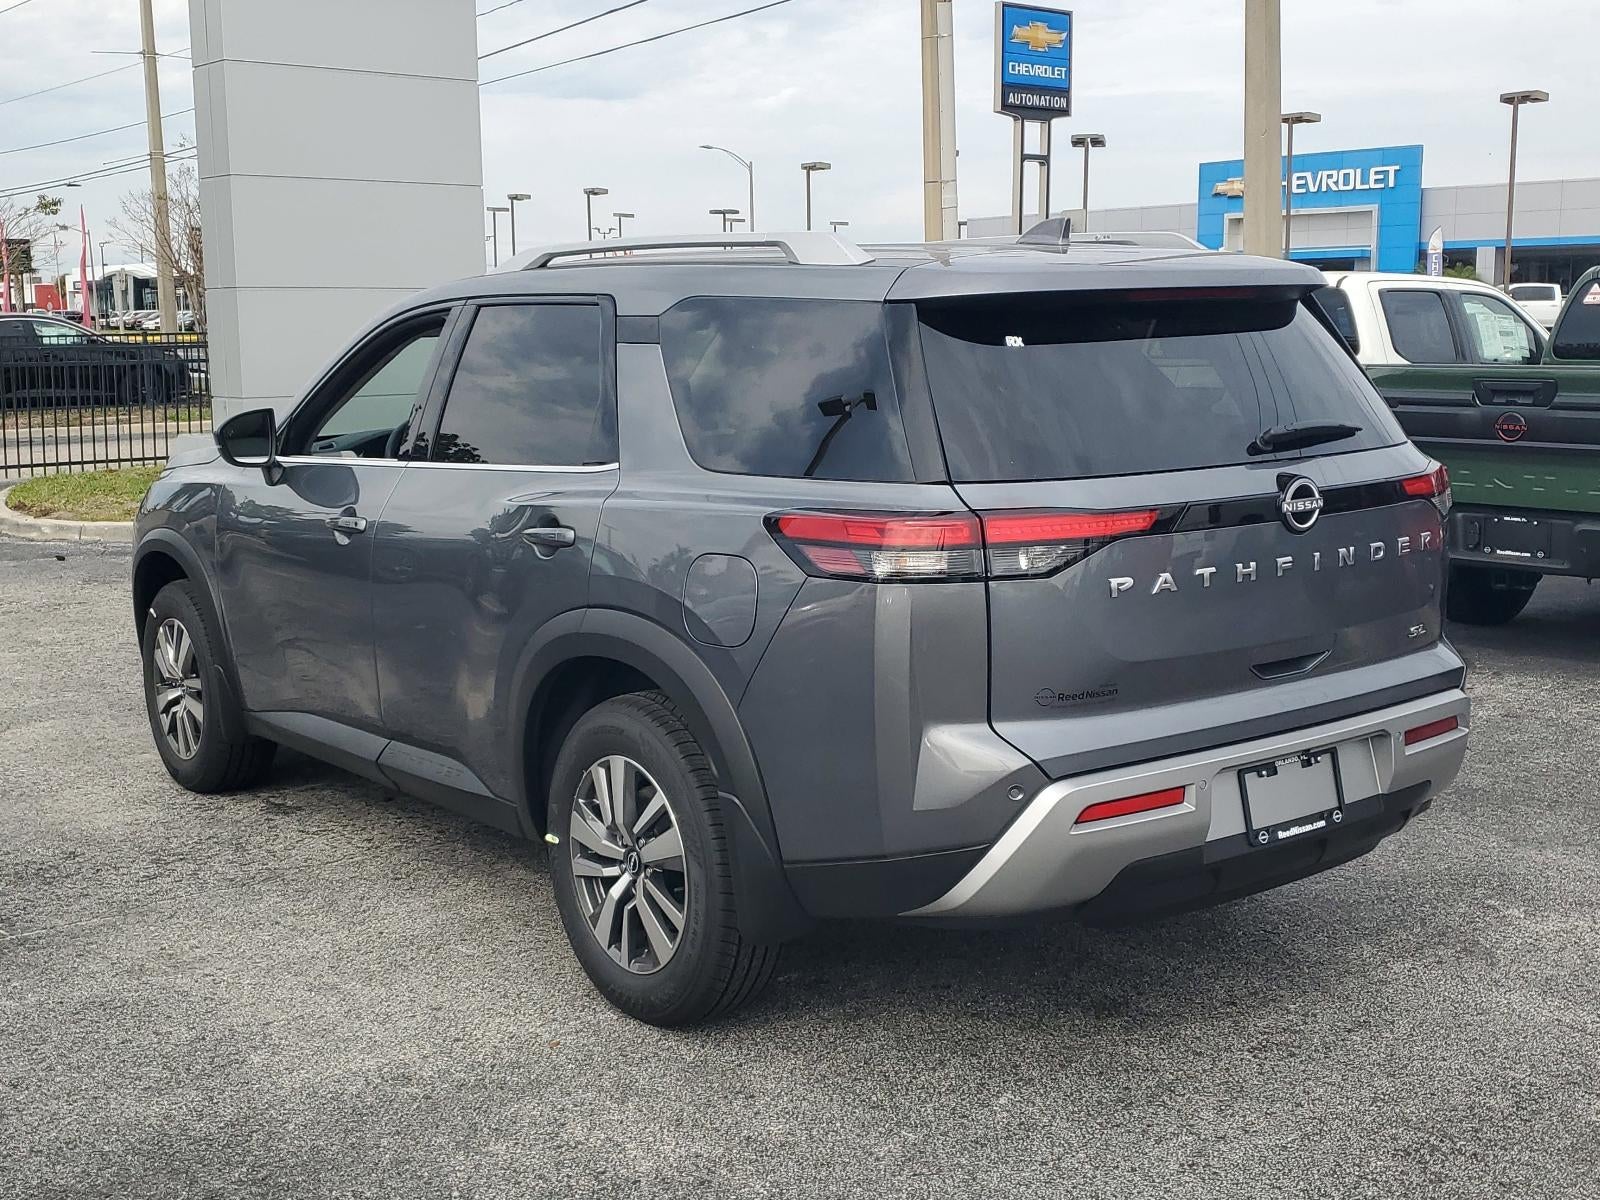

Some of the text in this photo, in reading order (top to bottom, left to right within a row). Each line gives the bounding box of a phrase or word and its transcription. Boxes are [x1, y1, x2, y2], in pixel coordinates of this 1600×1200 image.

[1008, 62, 1067, 79] CHEVROLET
[1008, 92, 1067, 108] AUTONATION
[1283, 165, 1400, 195] EVROLET
[1283, 500, 1323, 512] NISSAN
[1108, 531, 1432, 599] PATHFINDER
[1408, 623, 1426, 637] SL
[1277, 820, 1326, 840] ReedNissan.com
